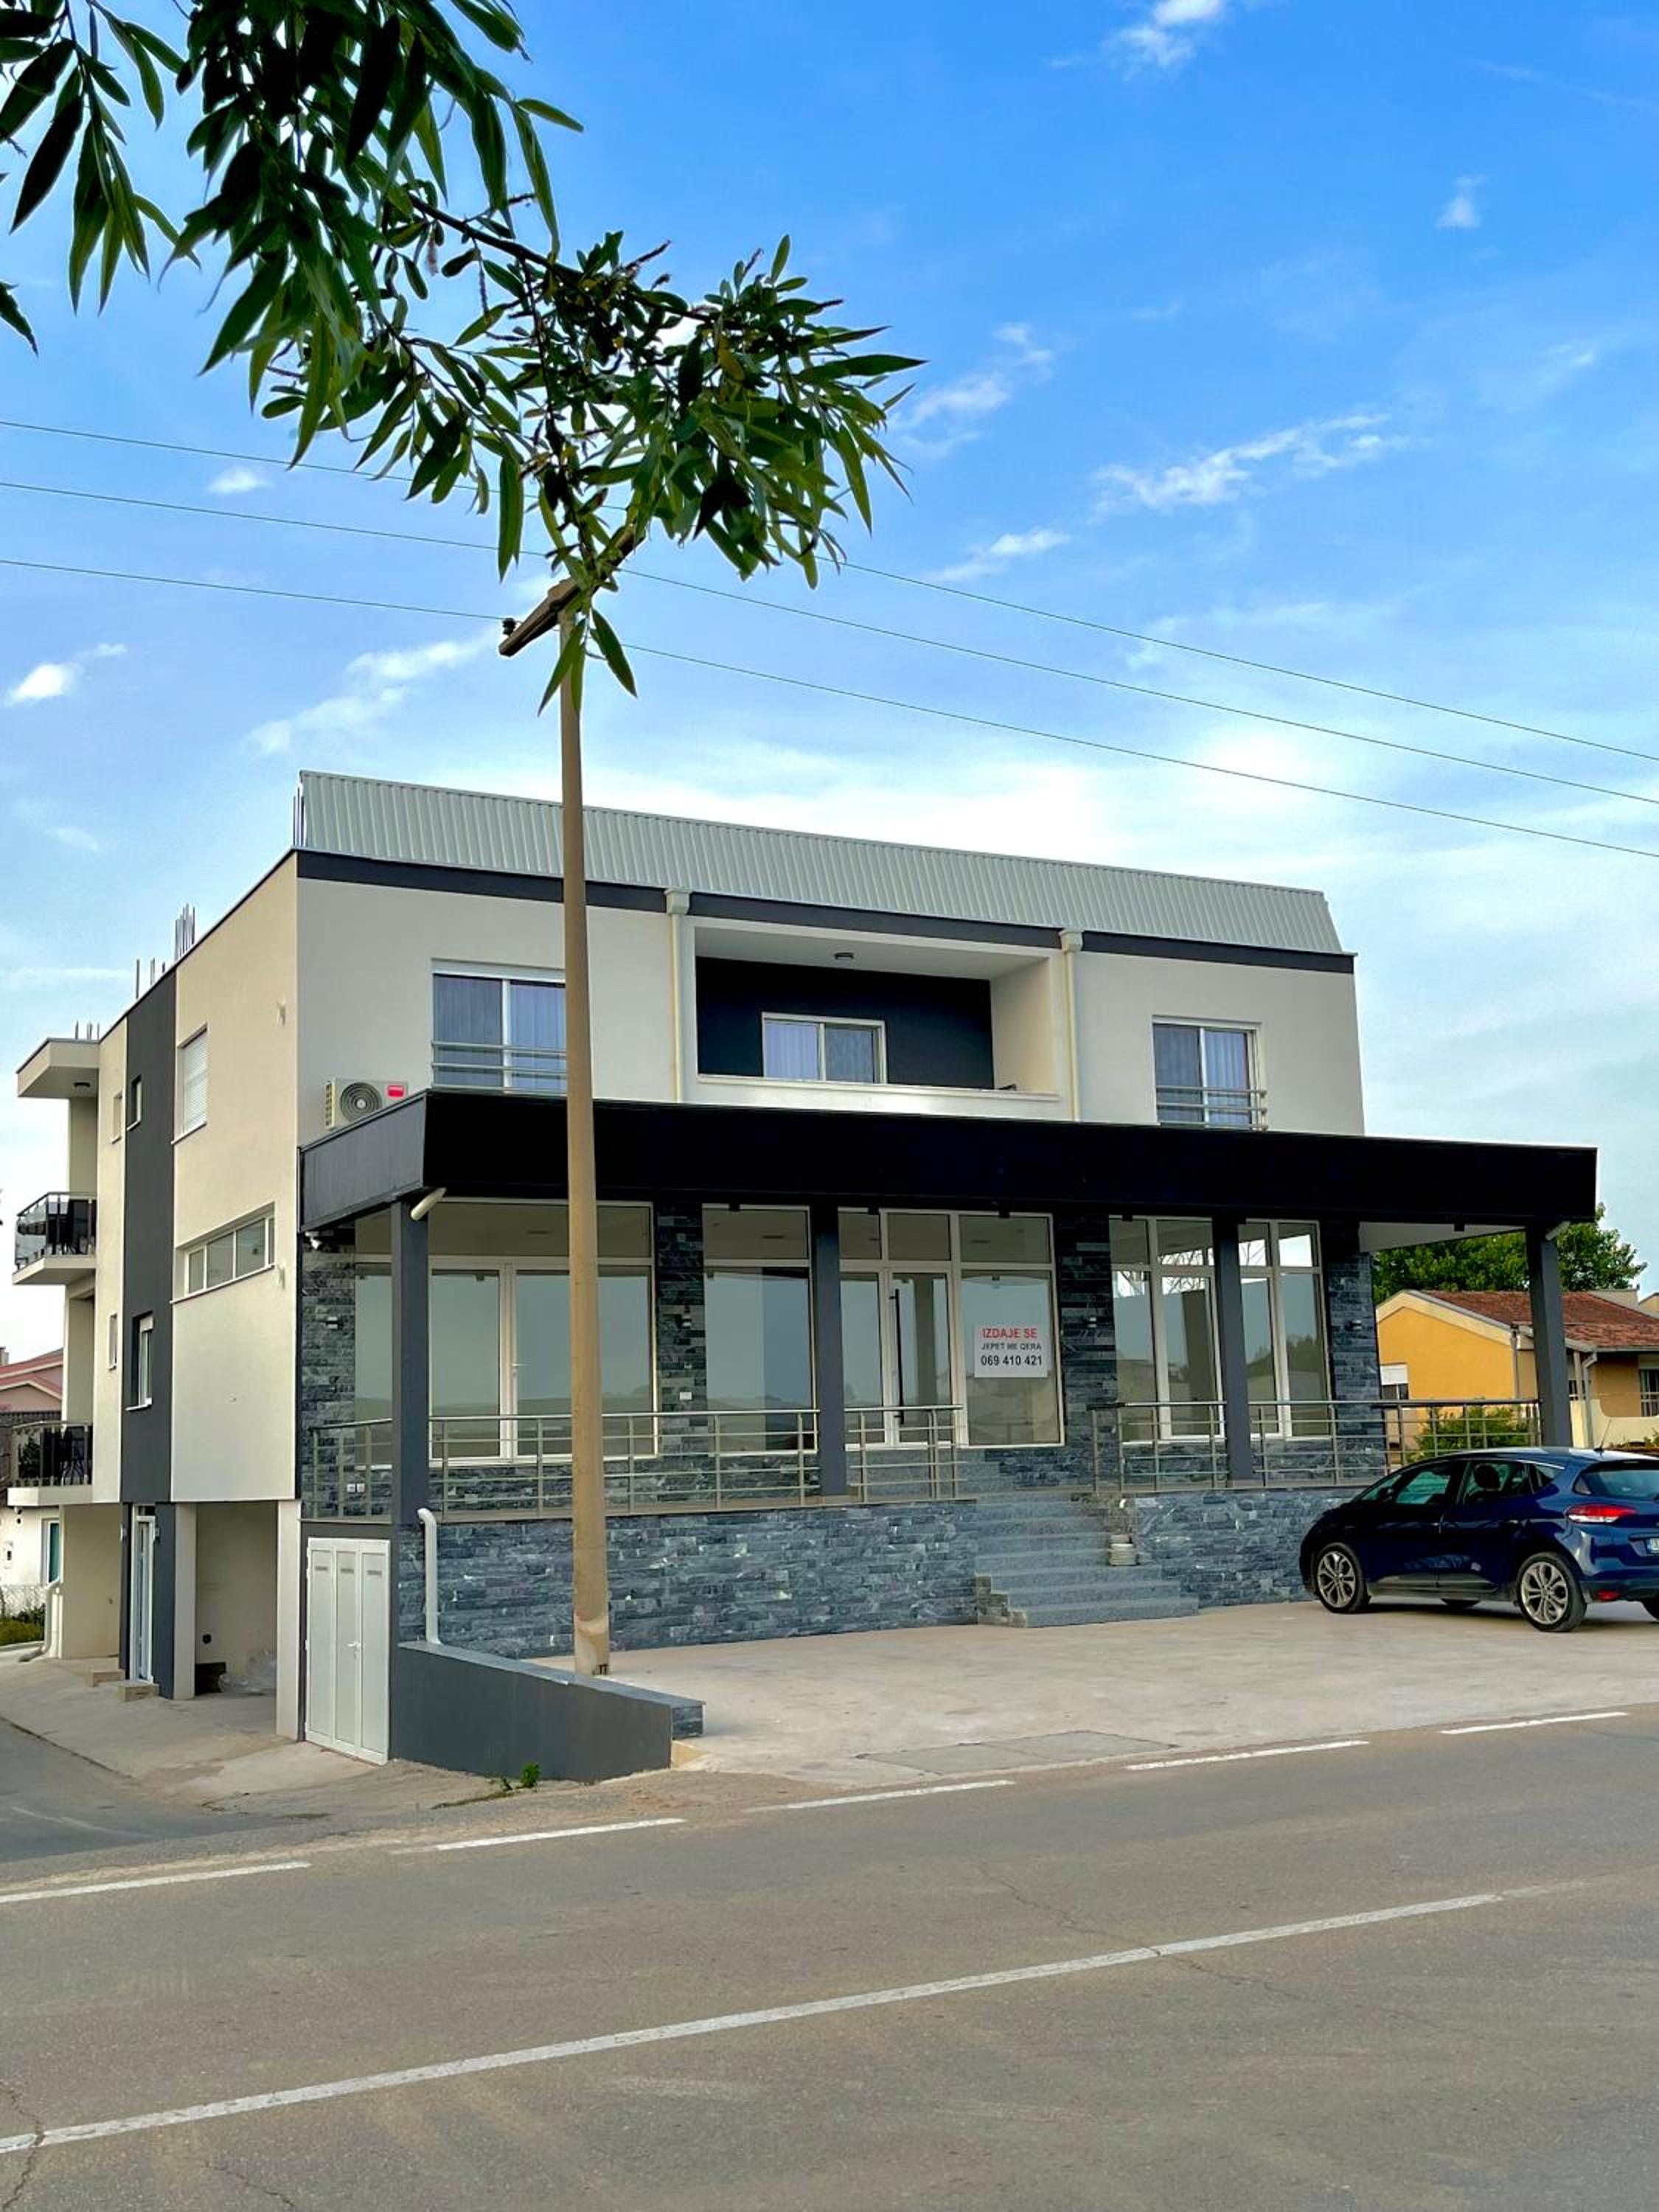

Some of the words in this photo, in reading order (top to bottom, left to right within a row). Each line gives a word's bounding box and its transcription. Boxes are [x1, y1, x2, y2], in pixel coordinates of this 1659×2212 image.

[982, 1328, 1021, 1338] IZDAJE
[1024, 1328, 1038, 1338] SE
[981, 1354, 999, 1366] 069
[1003, 1354, 1021, 1366] 410
[1024, 1354, 1042, 1366] 421
